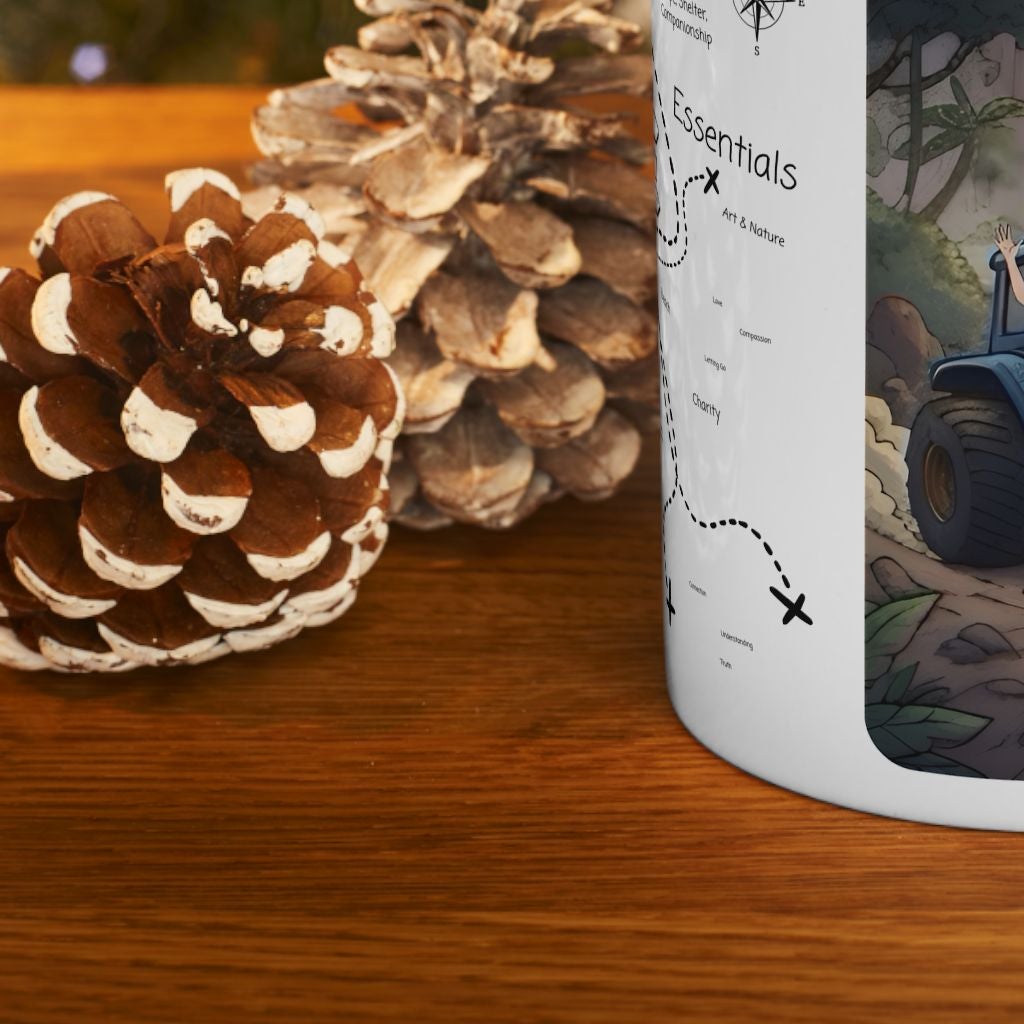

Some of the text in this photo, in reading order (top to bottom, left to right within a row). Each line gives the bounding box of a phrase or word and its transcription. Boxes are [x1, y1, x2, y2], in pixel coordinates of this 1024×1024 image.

[661, 3, 713, 50] Companionship
[754, 46, 760, 56] S
[673, 85, 798, 190] Essentials
[722, 207, 785, 248] Art & Nature
[739, 328, 772, 344] Compassion
[692, 392, 721, 426] Charity
[720, 629, 754, 652] Understanding
